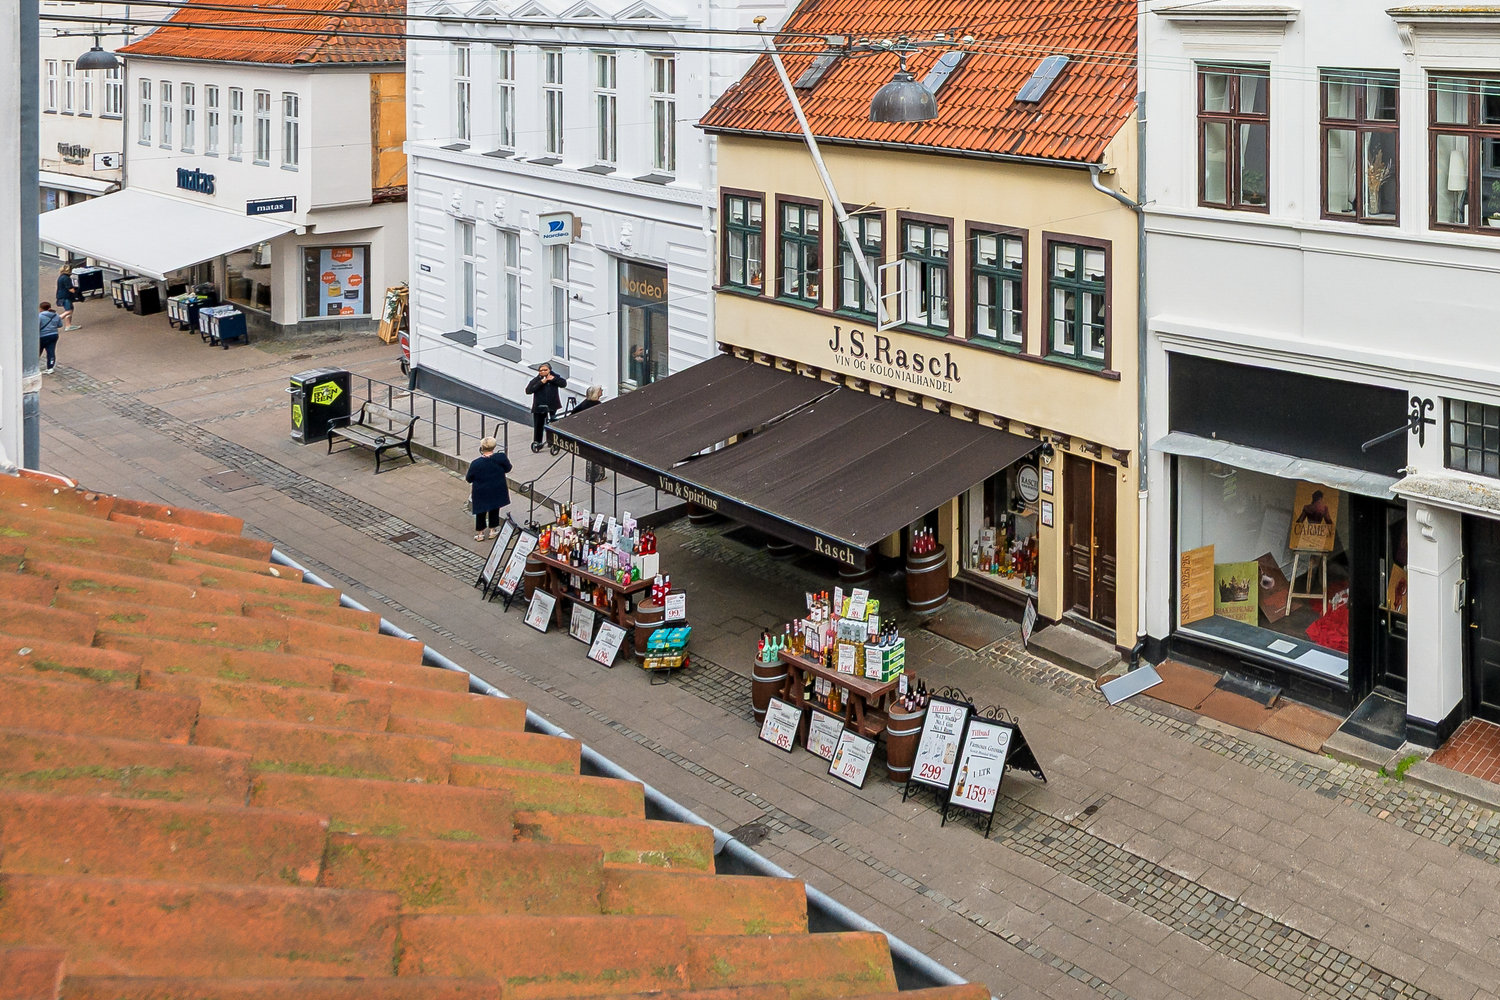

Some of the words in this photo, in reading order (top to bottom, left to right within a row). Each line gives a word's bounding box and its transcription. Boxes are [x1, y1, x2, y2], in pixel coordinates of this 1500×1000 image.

[176, 167, 216, 195] matas
[256, 203, 284, 213] matas
[622, 276, 662, 299] Nordea
[874, 335, 962, 383] Rasch
[835, 354, 851, 367] VIN
[854, 358, 866, 371] OG
[869, 363, 953, 394] KOLONIALHANDEL
[553, 433, 580, 455] Rasch
[658, 475, 674, 491] Vin
[675, 483, 682, 497] &
[683, 486, 718, 511] Spiritus
[1294, 523, 1334, 538] CARMEN
[814, 536, 855, 566] Rasch
[969, 741, 987, 750] Famous
[978, 767, 991, 776] LTR
